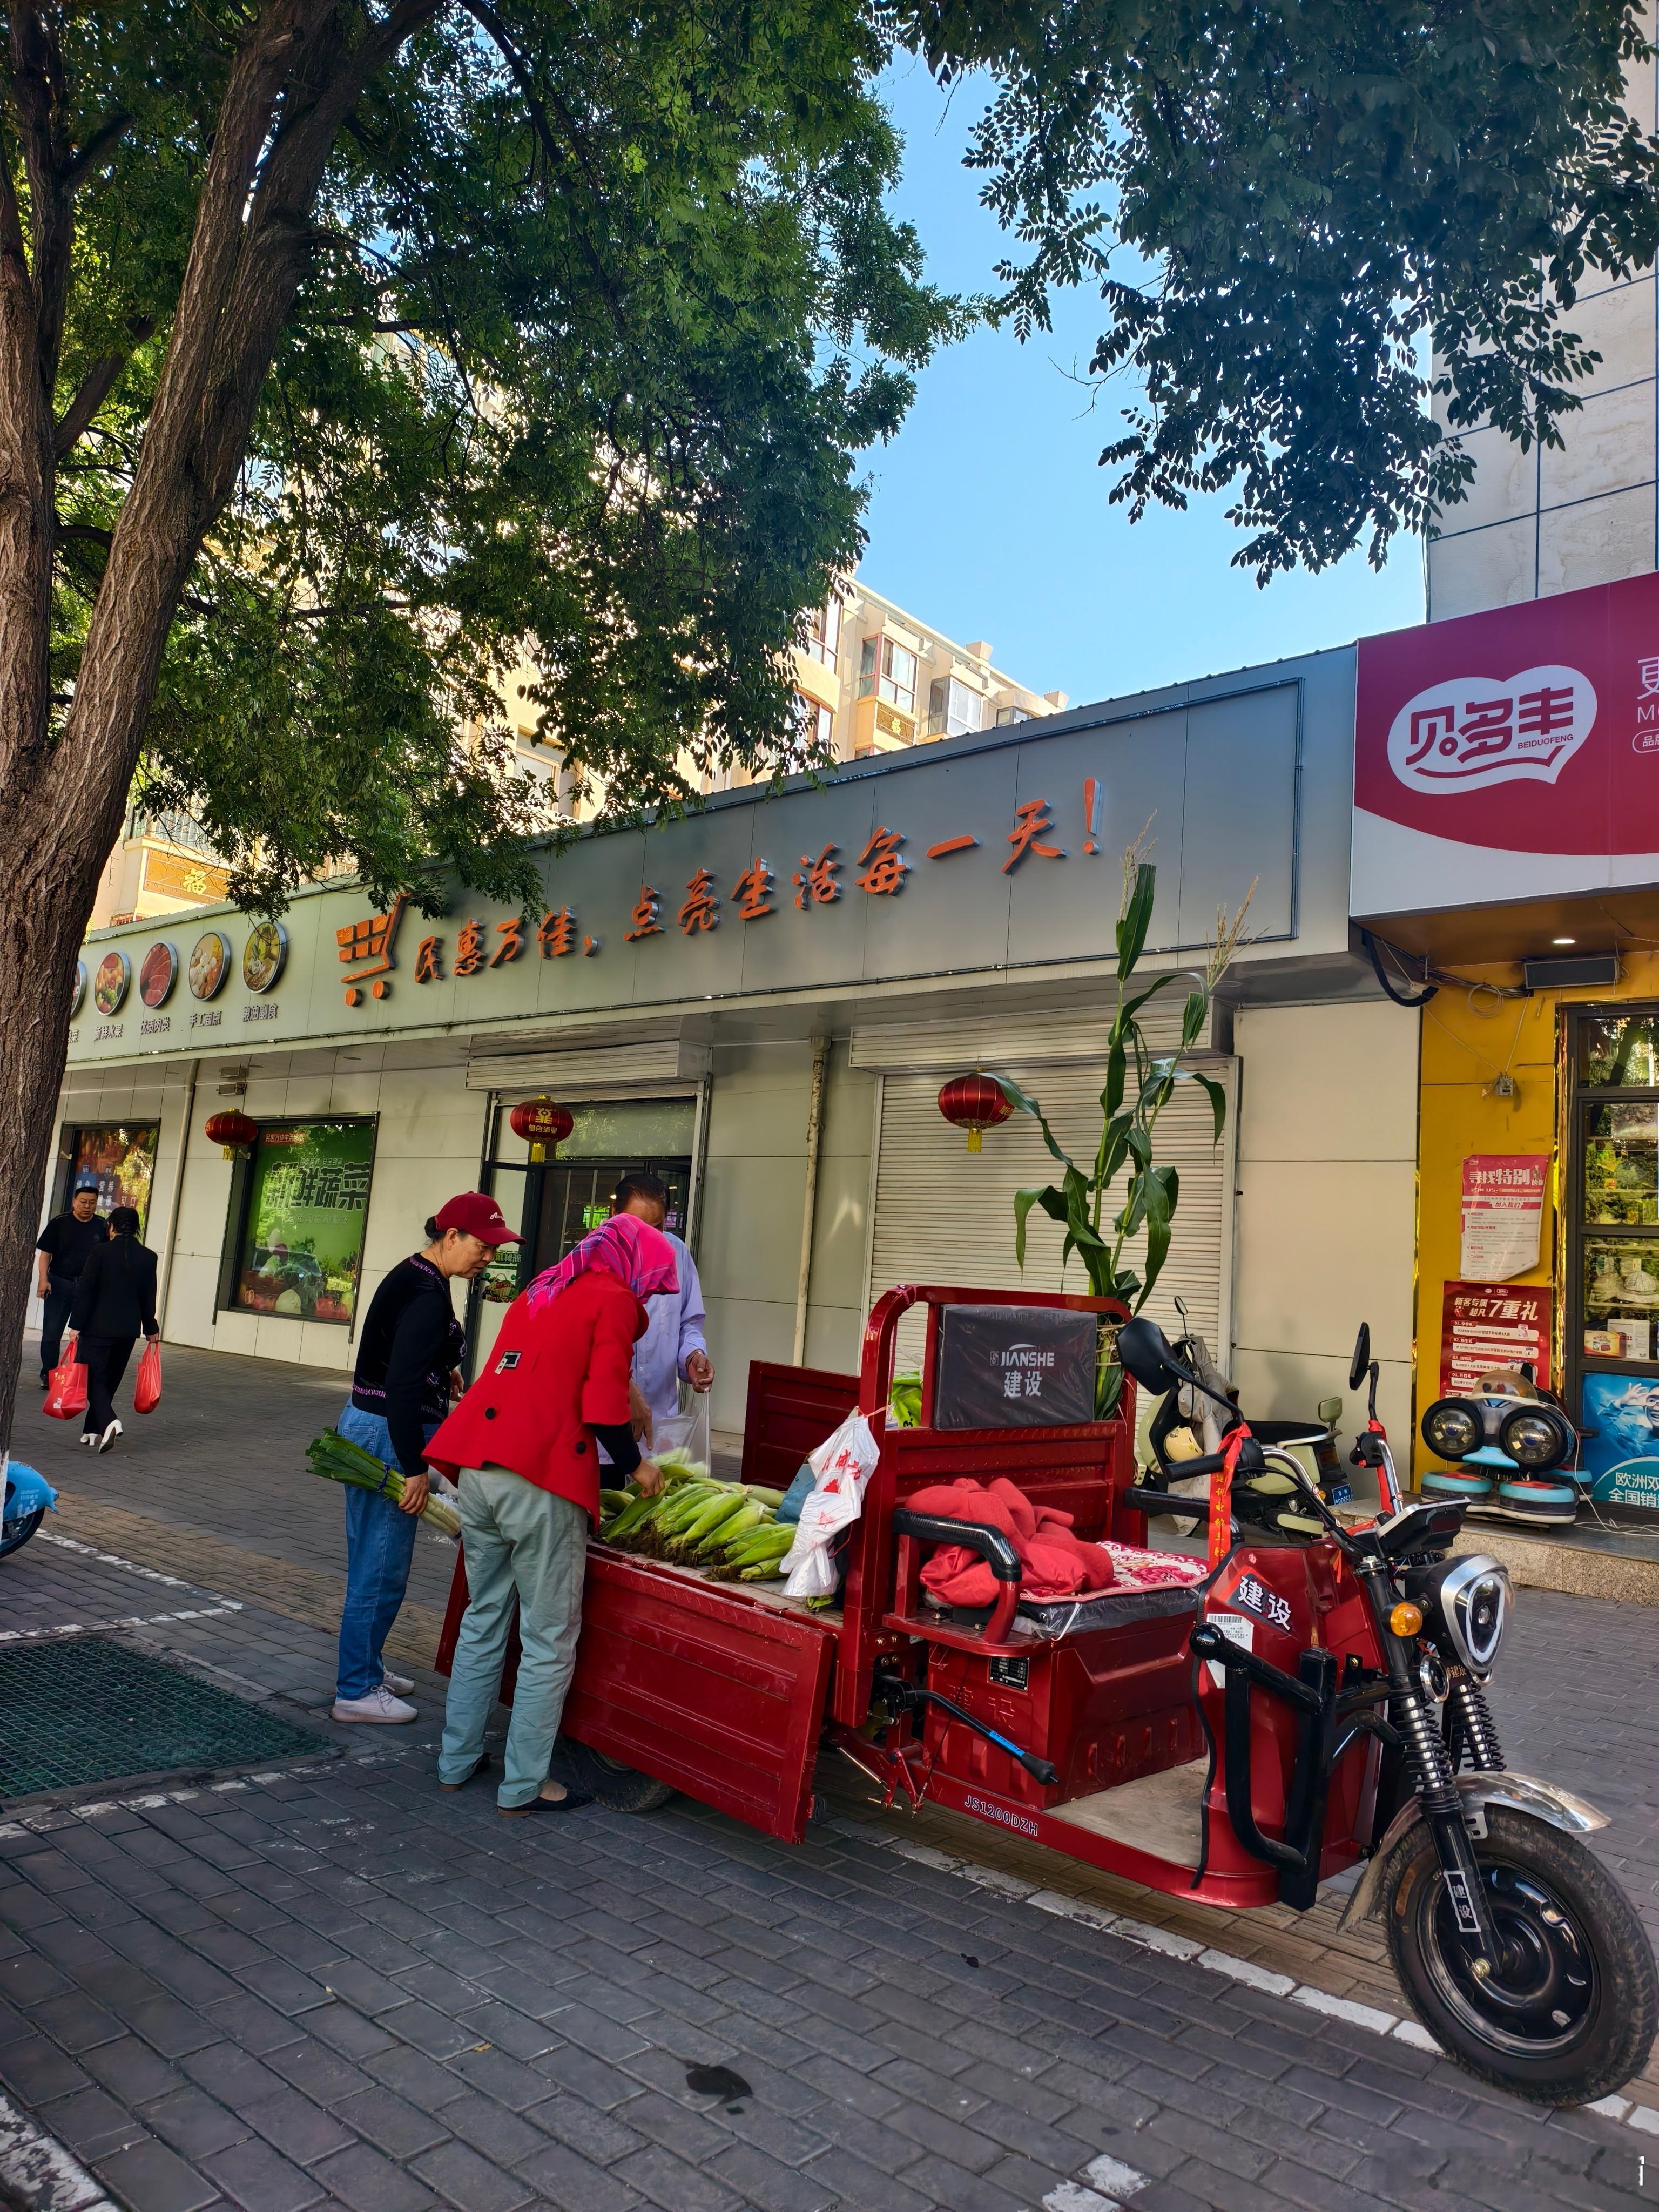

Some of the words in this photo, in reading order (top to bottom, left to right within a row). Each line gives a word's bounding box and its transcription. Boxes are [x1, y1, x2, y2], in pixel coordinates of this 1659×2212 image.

[1637, 704, 1659, 723] M
[1406, 686, 1574, 766] 贝多丰
[1517, 734, 1574, 750] BEIDUOFENG
[189, 1010, 222, 1028] 手工面点
[242, 1003, 279, 1022] 粮油副食
[94, 1024, 123, 1041] 新鲜水果
[140, 1017, 170, 1035] 优质肉类
[68, 1029, 79, 1043] 菜
[265, 1161, 370, 1211] 新鲜蔬菜
[1469, 1169, 1530, 1185] 寻找特别
[1454, 1297, 1488, 1307] 新客专属
[1488, 1300, 1539, 1321] 7重礼
[1469, 1308, 1486, 1317] 超凡
[1000, 1352, 1055, 1366] JIANSHE
[1003, 1370, 1042, 1398] 建设
[1608, 1487, 1659, 1507] 全国销
[1238, 1575, 1292, 1631] 建设
[964, 1794, 1038, 1837] JS1200DZH
